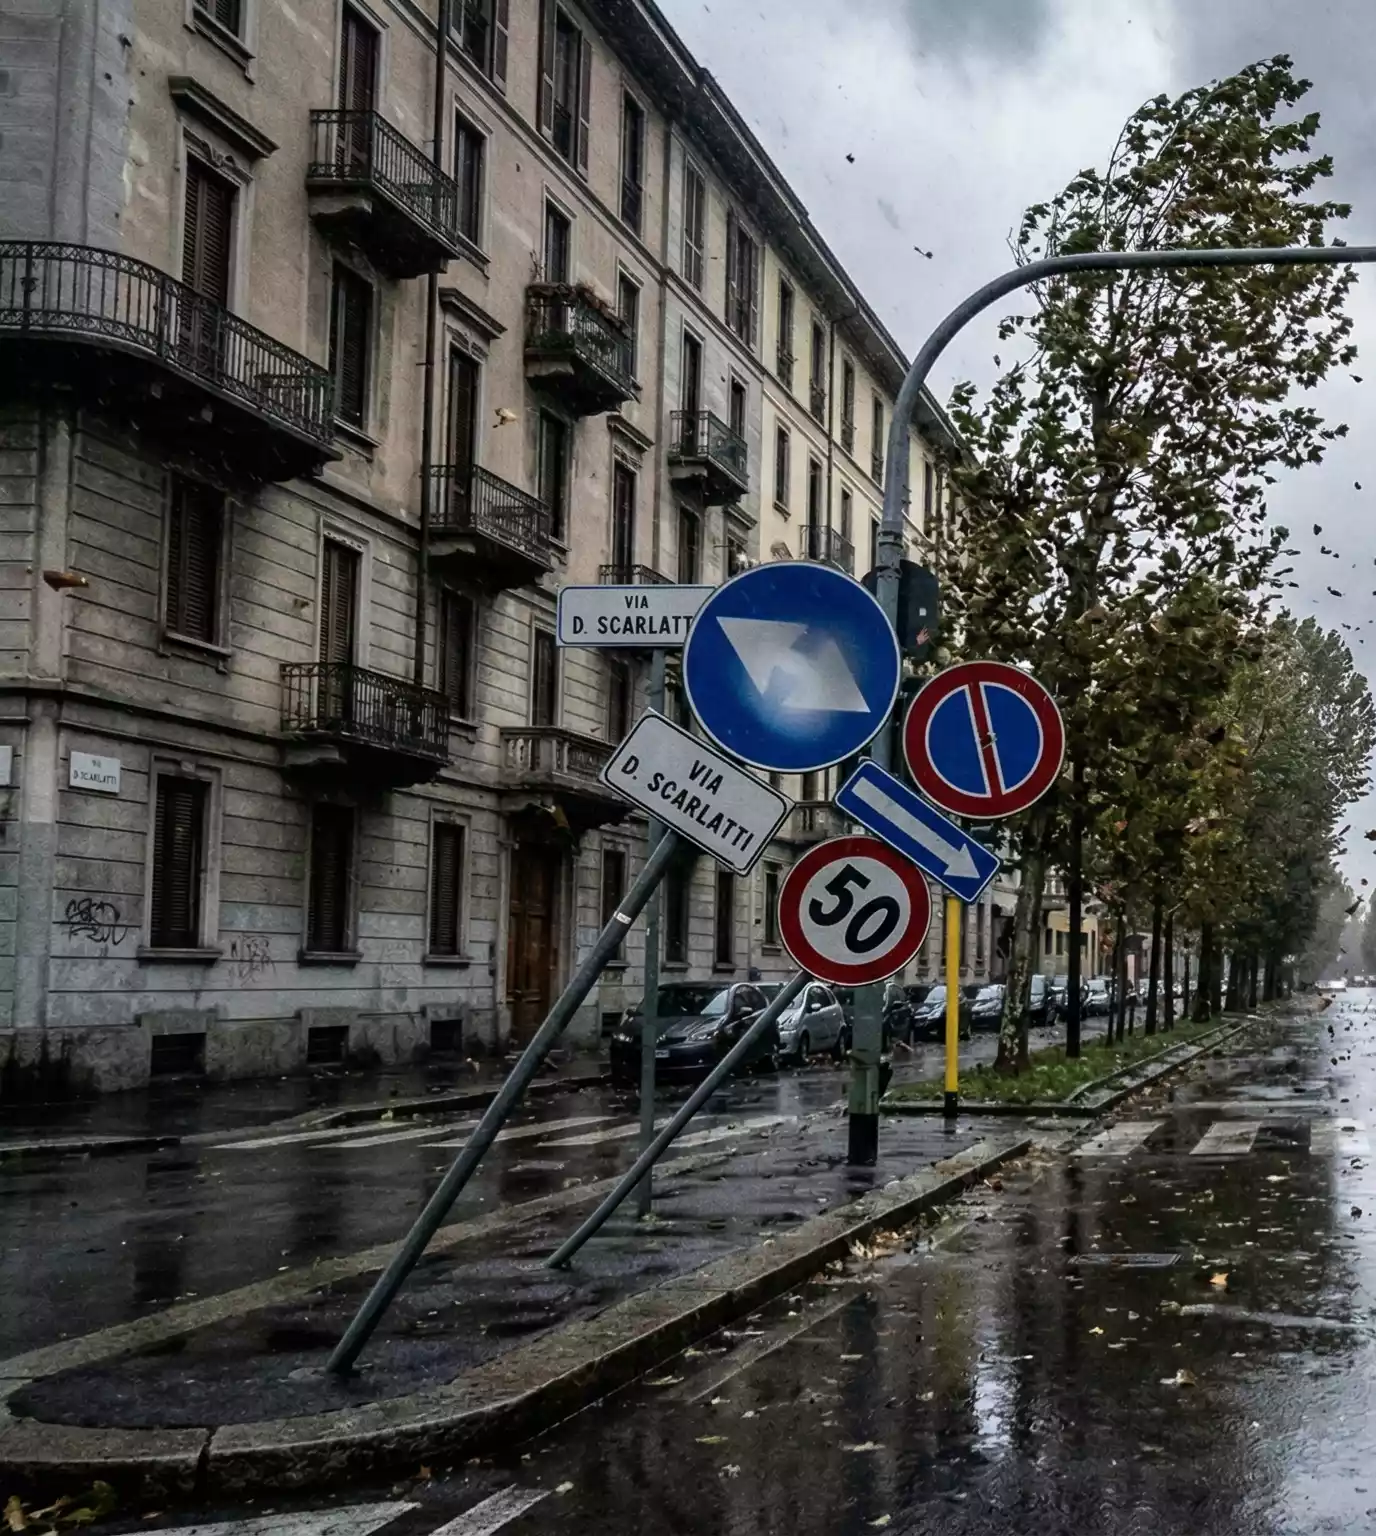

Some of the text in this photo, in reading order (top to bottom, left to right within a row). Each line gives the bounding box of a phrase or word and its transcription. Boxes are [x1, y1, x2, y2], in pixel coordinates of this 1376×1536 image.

[625, 595, 648, 609] VIA
[572, 615, 693, 635] D. SCARLATT
[688, 759, 724, 796] VIA
[621, 755, 755, 852] D. SCARLATTI
[808, 863, 901, 954] 50
